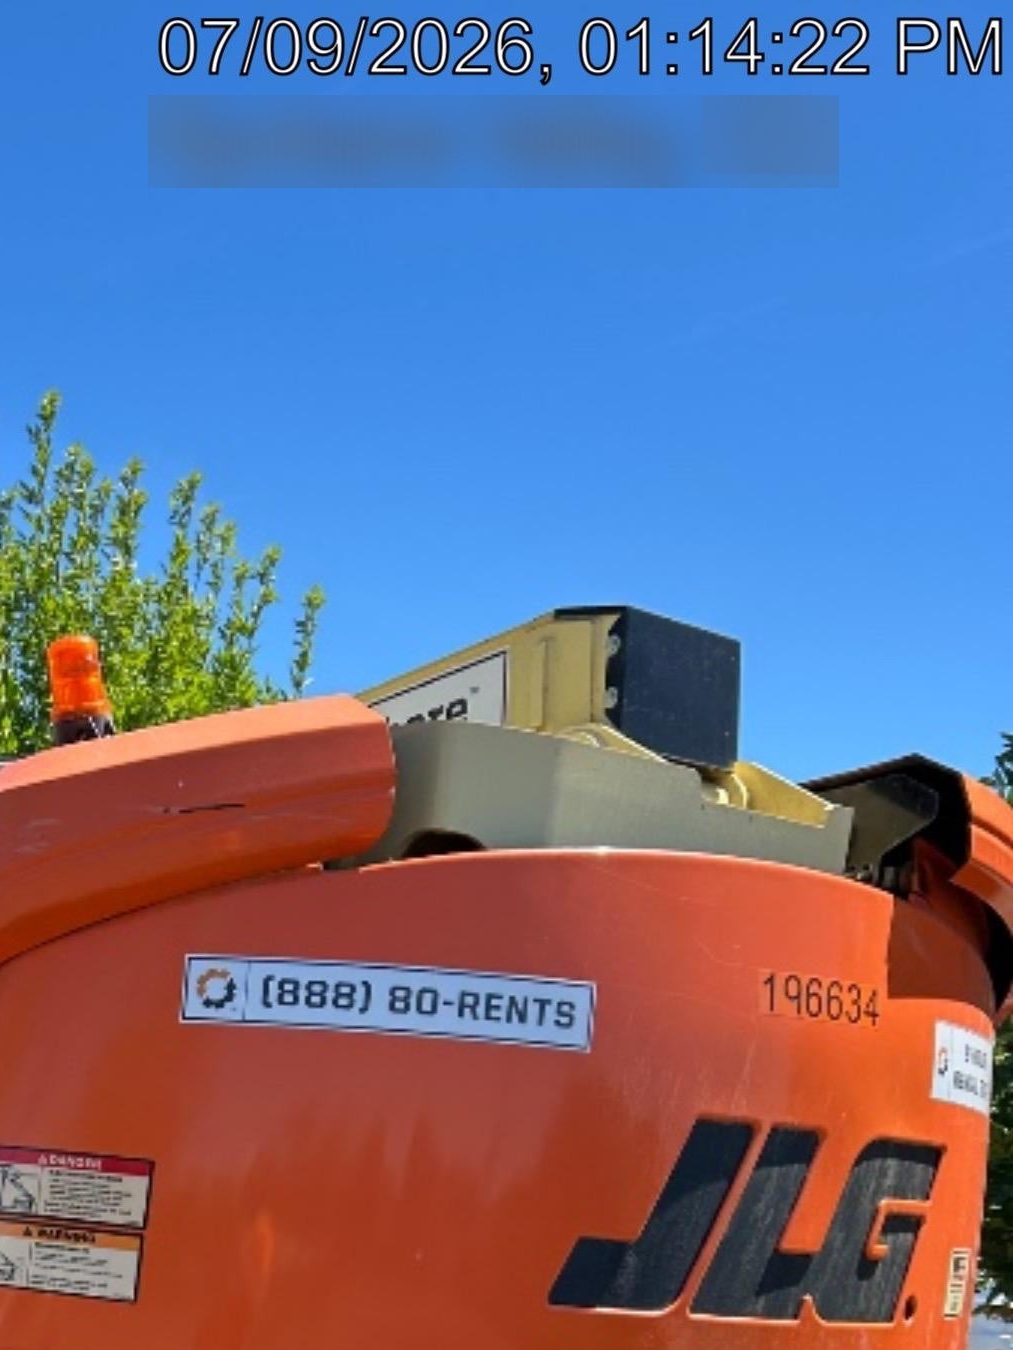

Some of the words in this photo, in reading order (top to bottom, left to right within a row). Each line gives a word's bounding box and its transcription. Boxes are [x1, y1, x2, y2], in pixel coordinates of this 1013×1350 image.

[262, 974, 372, 1015] (888)
[387, 985, 577, 1030] 80-RENTS
[763, 972, 880, 1027] 196634
[547, 1117, 945, 1324] JLG
